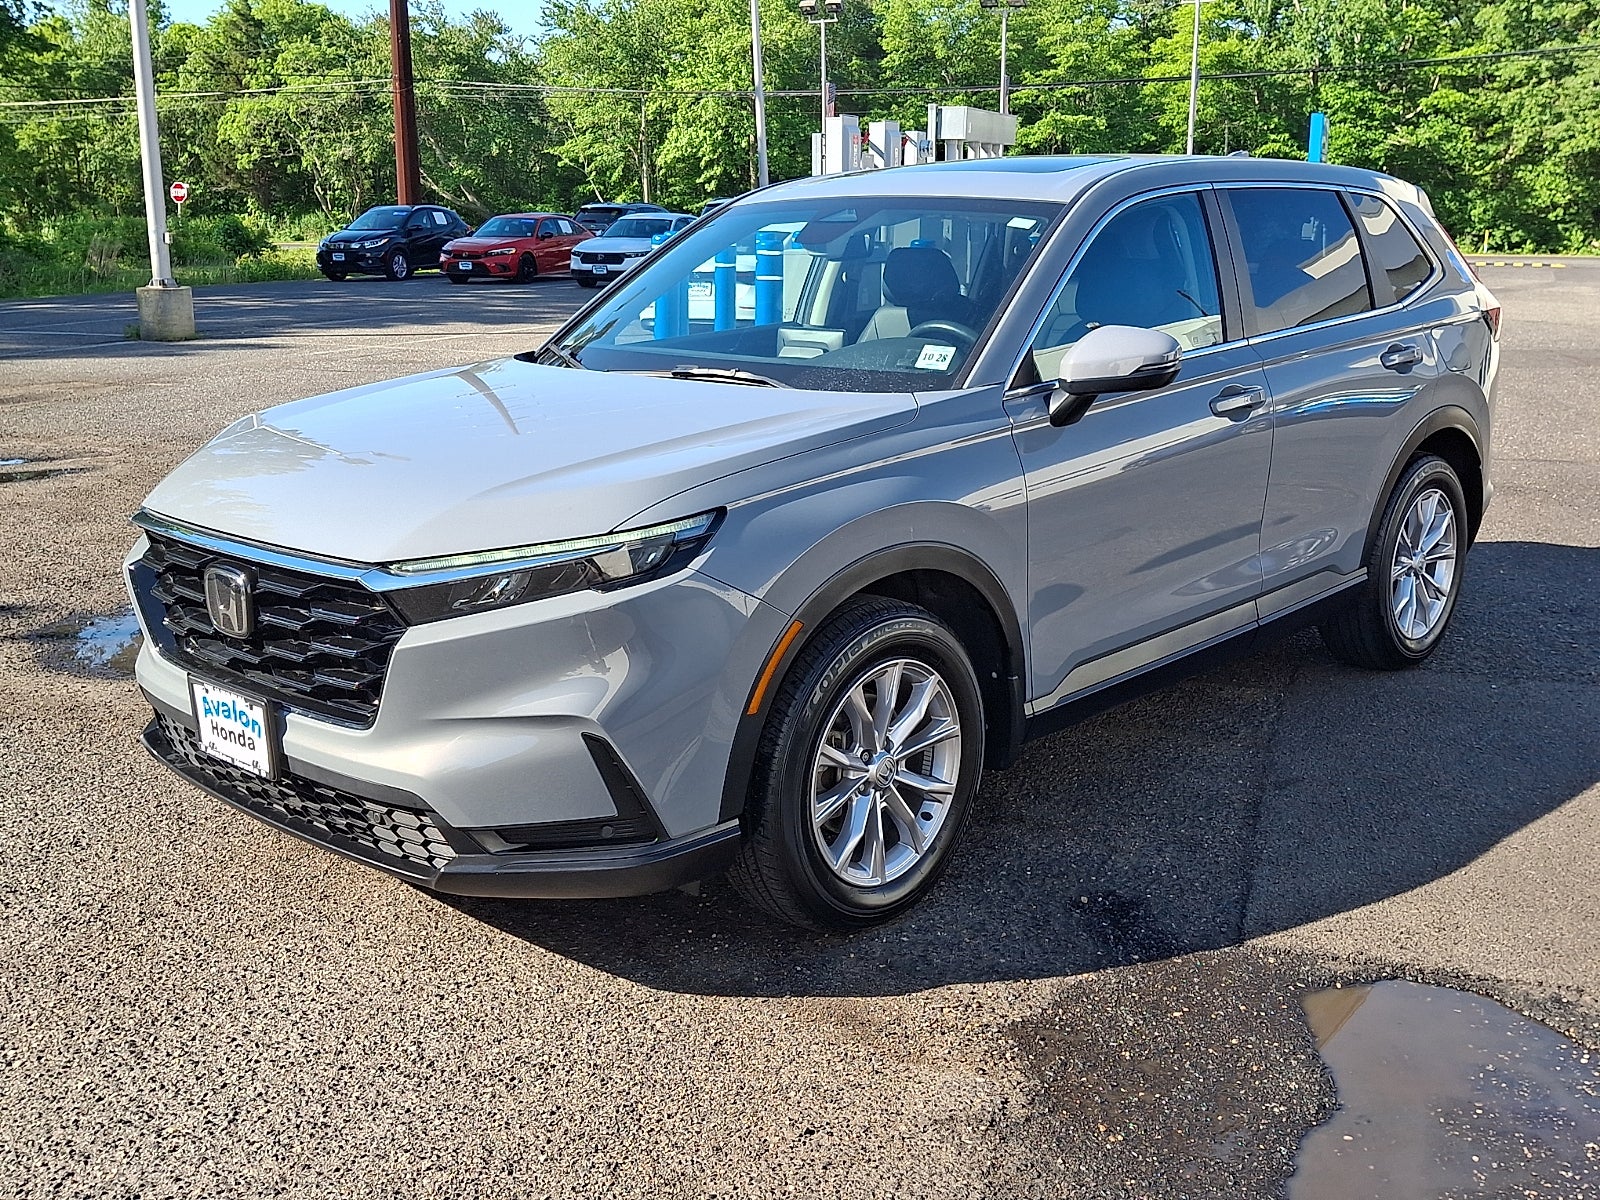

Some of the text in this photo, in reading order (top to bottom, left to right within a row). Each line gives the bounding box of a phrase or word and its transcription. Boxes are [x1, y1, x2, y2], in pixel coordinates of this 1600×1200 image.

[922, 353, 935, 361] 10
[202, 696, 261, 739] Avalon
[211, 719, 256, 751] Honda
